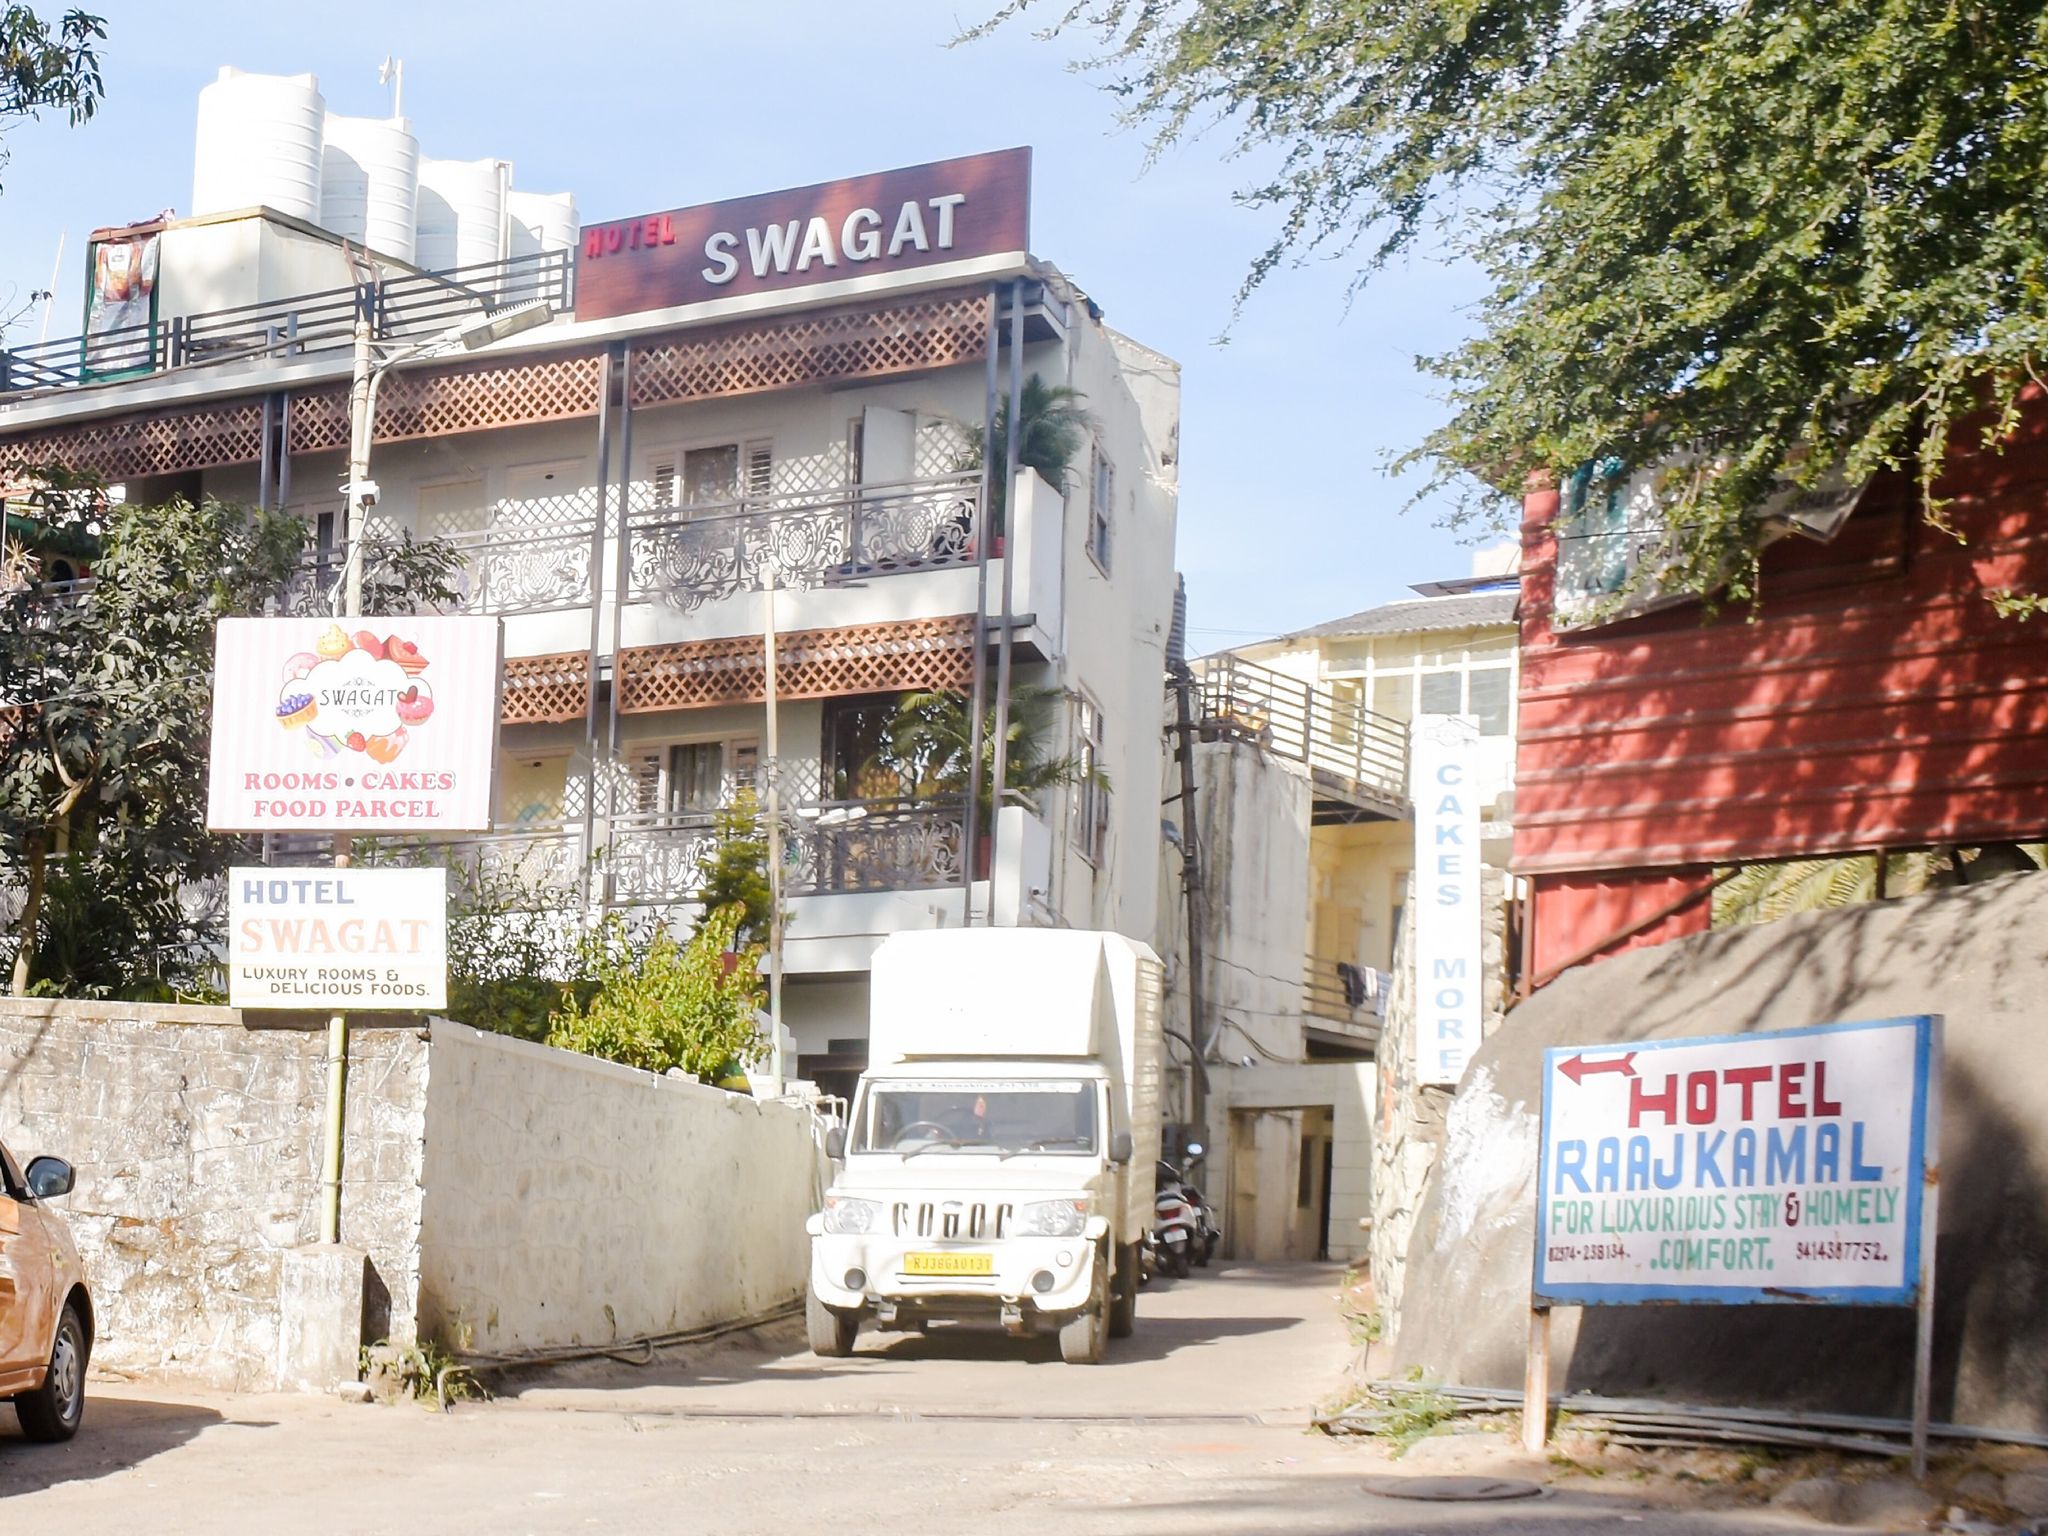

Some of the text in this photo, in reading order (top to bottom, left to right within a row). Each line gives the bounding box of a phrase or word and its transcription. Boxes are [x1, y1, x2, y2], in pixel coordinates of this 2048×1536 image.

[585, 193, 966, 285] HOTEL SWAGAT
[319, 689, 397, 706] SWAGAT
[244, 773, 456, 791] ROOMS CAKES
[254, 800, 441, 818] FOOD PARCEL
[1435, 764, 1464, 906] CAKES
[243, 880, 355, 904] HOTEL
[239, 918, 432, 954] SWAGAT
[243, 967, 399, 982] LUXURY ROOMS &
[270, 982, 430, 996] DELICIOUS FOODS.
[1433, 958, 1467, 1070] MORE
[1628, 1061, 1842, 1128] HOTEL
[1554, 1121, 1884, 1195] RAAJKAMAL
[1551, 1201, 1593, 1236] FOR
[1602, 1194, 1726, 1234] LUXURIOUS
[1734, 1191, 1782, 1230] STAY
[1804, 1187, 1899, 1225] HOMELY
